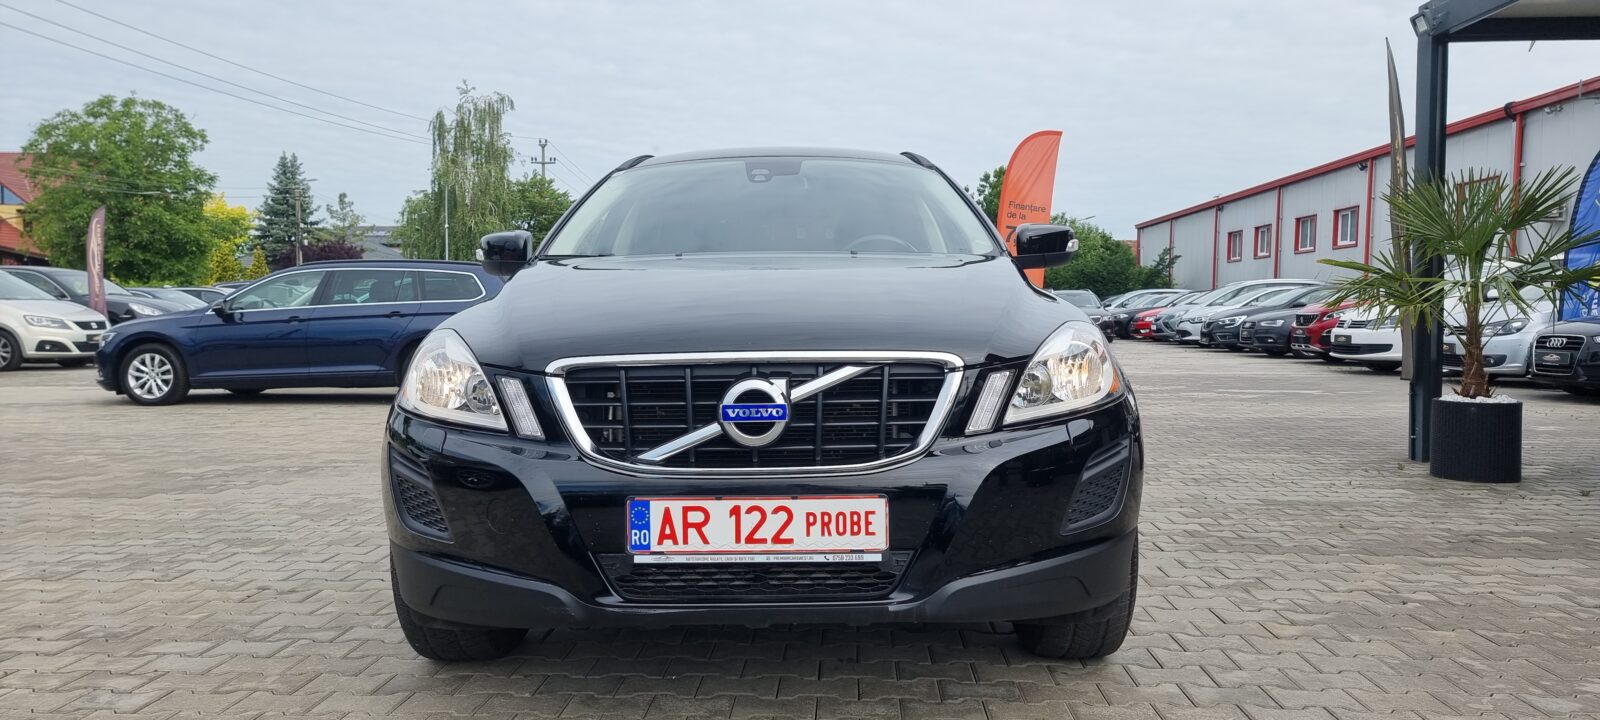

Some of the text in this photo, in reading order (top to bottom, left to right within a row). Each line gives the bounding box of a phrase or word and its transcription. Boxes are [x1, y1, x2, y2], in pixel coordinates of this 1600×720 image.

[1006, 211, 1026, 220] de la
[725, 408, 784, 418] VOLVO
[657, 505, 877, 546] AR 122 PROBE
[631, 529, 650, 546] RO
